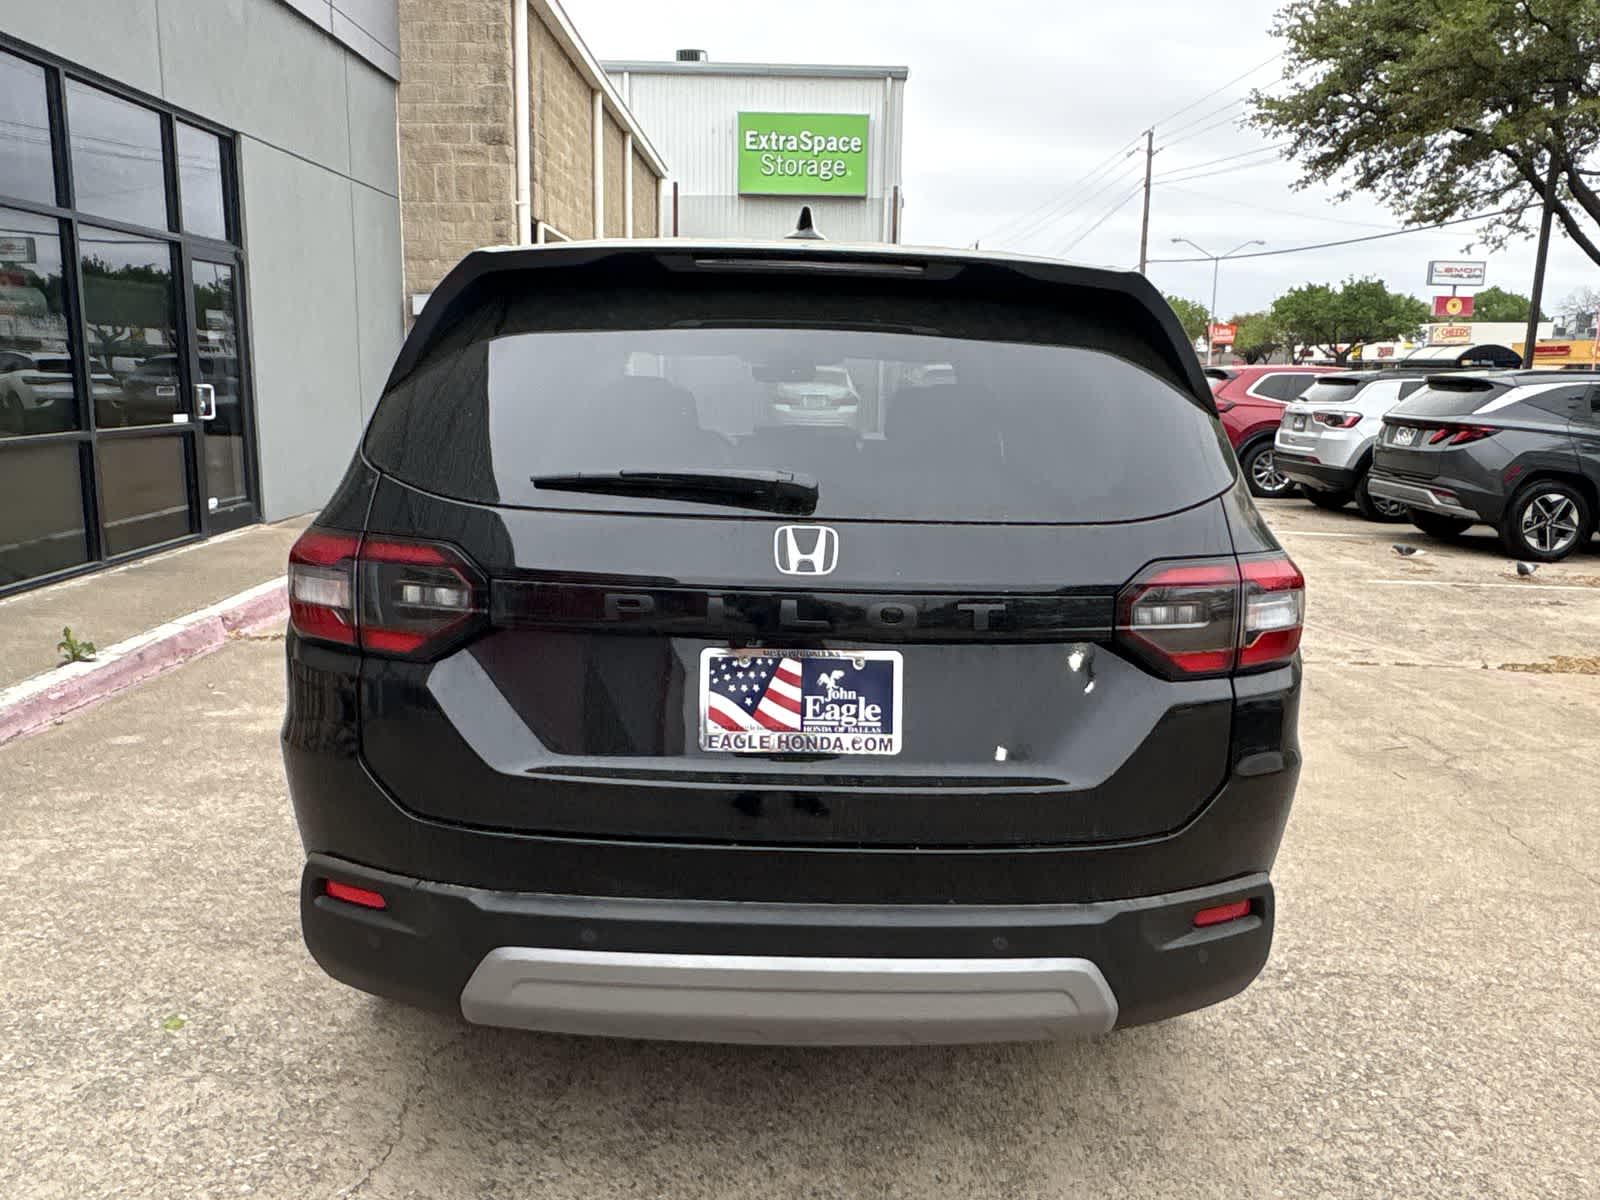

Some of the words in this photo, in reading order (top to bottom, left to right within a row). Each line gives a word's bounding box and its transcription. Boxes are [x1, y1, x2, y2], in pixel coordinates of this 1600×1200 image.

[761, 153, 846, 180] Storage
[604, 592, 1007, 630] PILOT
[825, 687, 857, 702] John
[803, 695, 882, 727] Eagle
[847, 726, 882, 734] DALLAS
